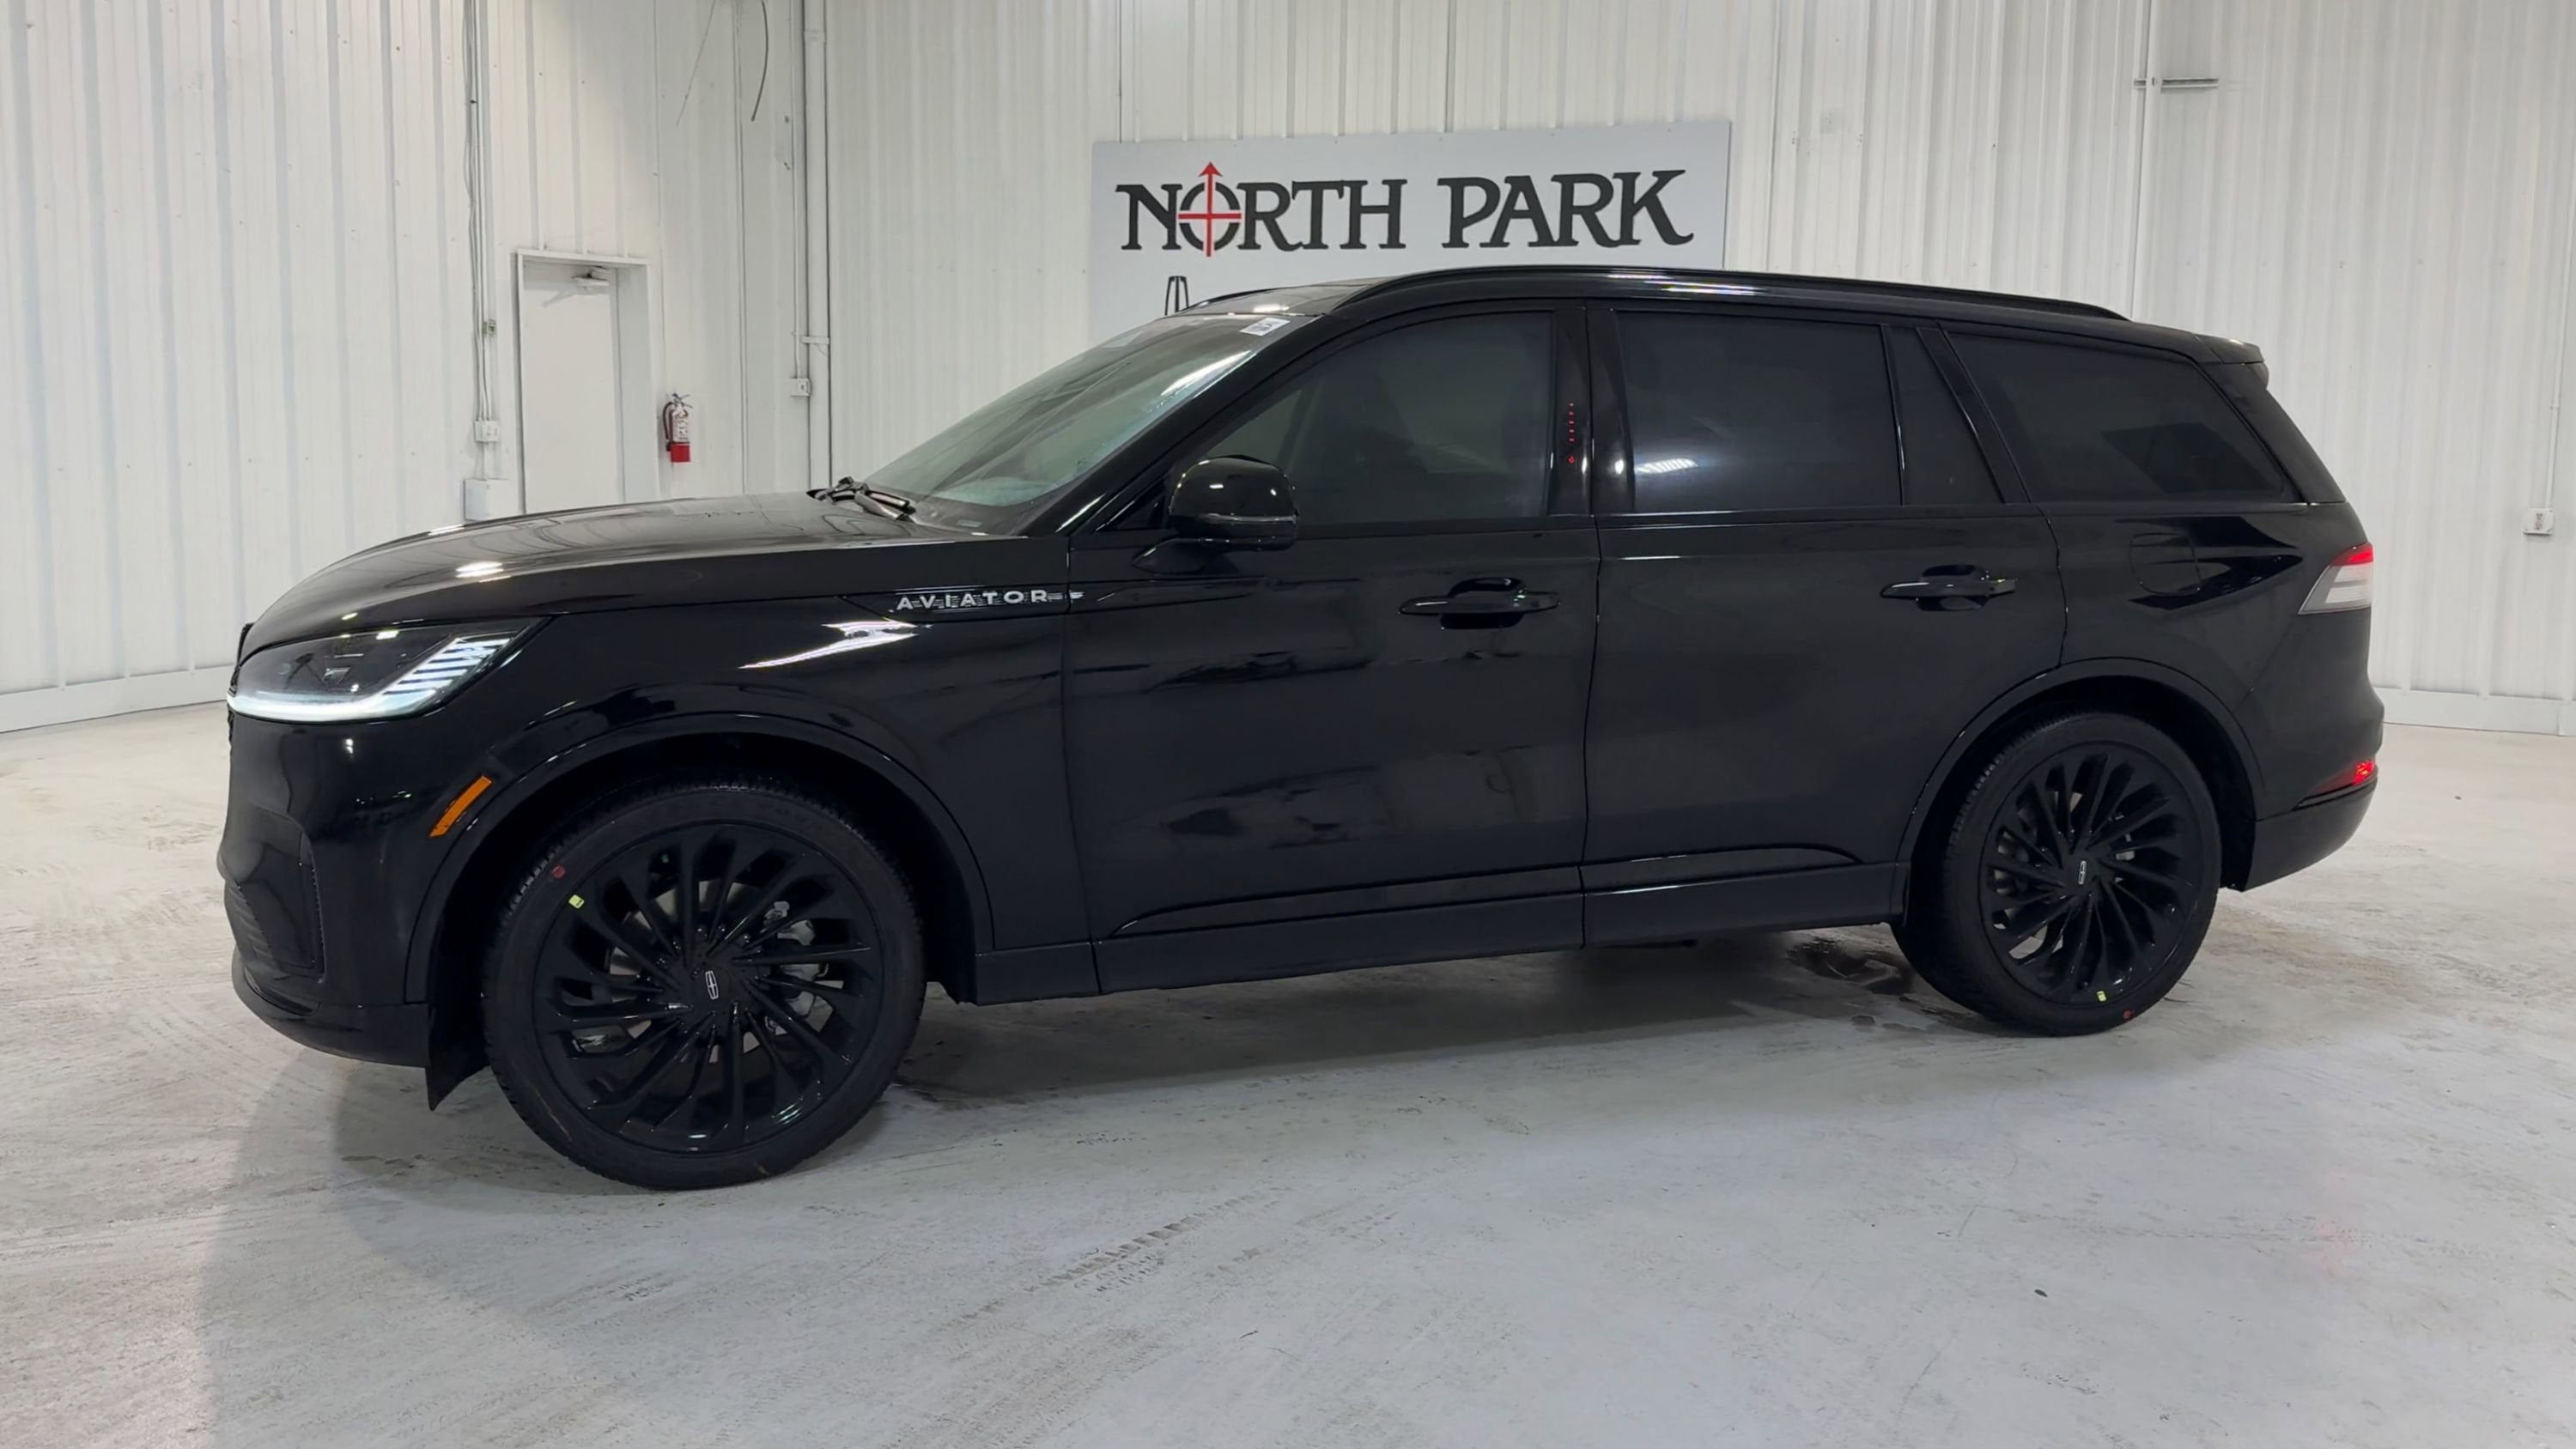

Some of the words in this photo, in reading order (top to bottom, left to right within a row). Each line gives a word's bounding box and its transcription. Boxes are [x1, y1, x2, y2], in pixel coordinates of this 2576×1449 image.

[1115, 179, 1408, 251] NORTH
[1437, 169, 1694, 249] PARK
[896, 590, 1048, 610] AVIATOR
